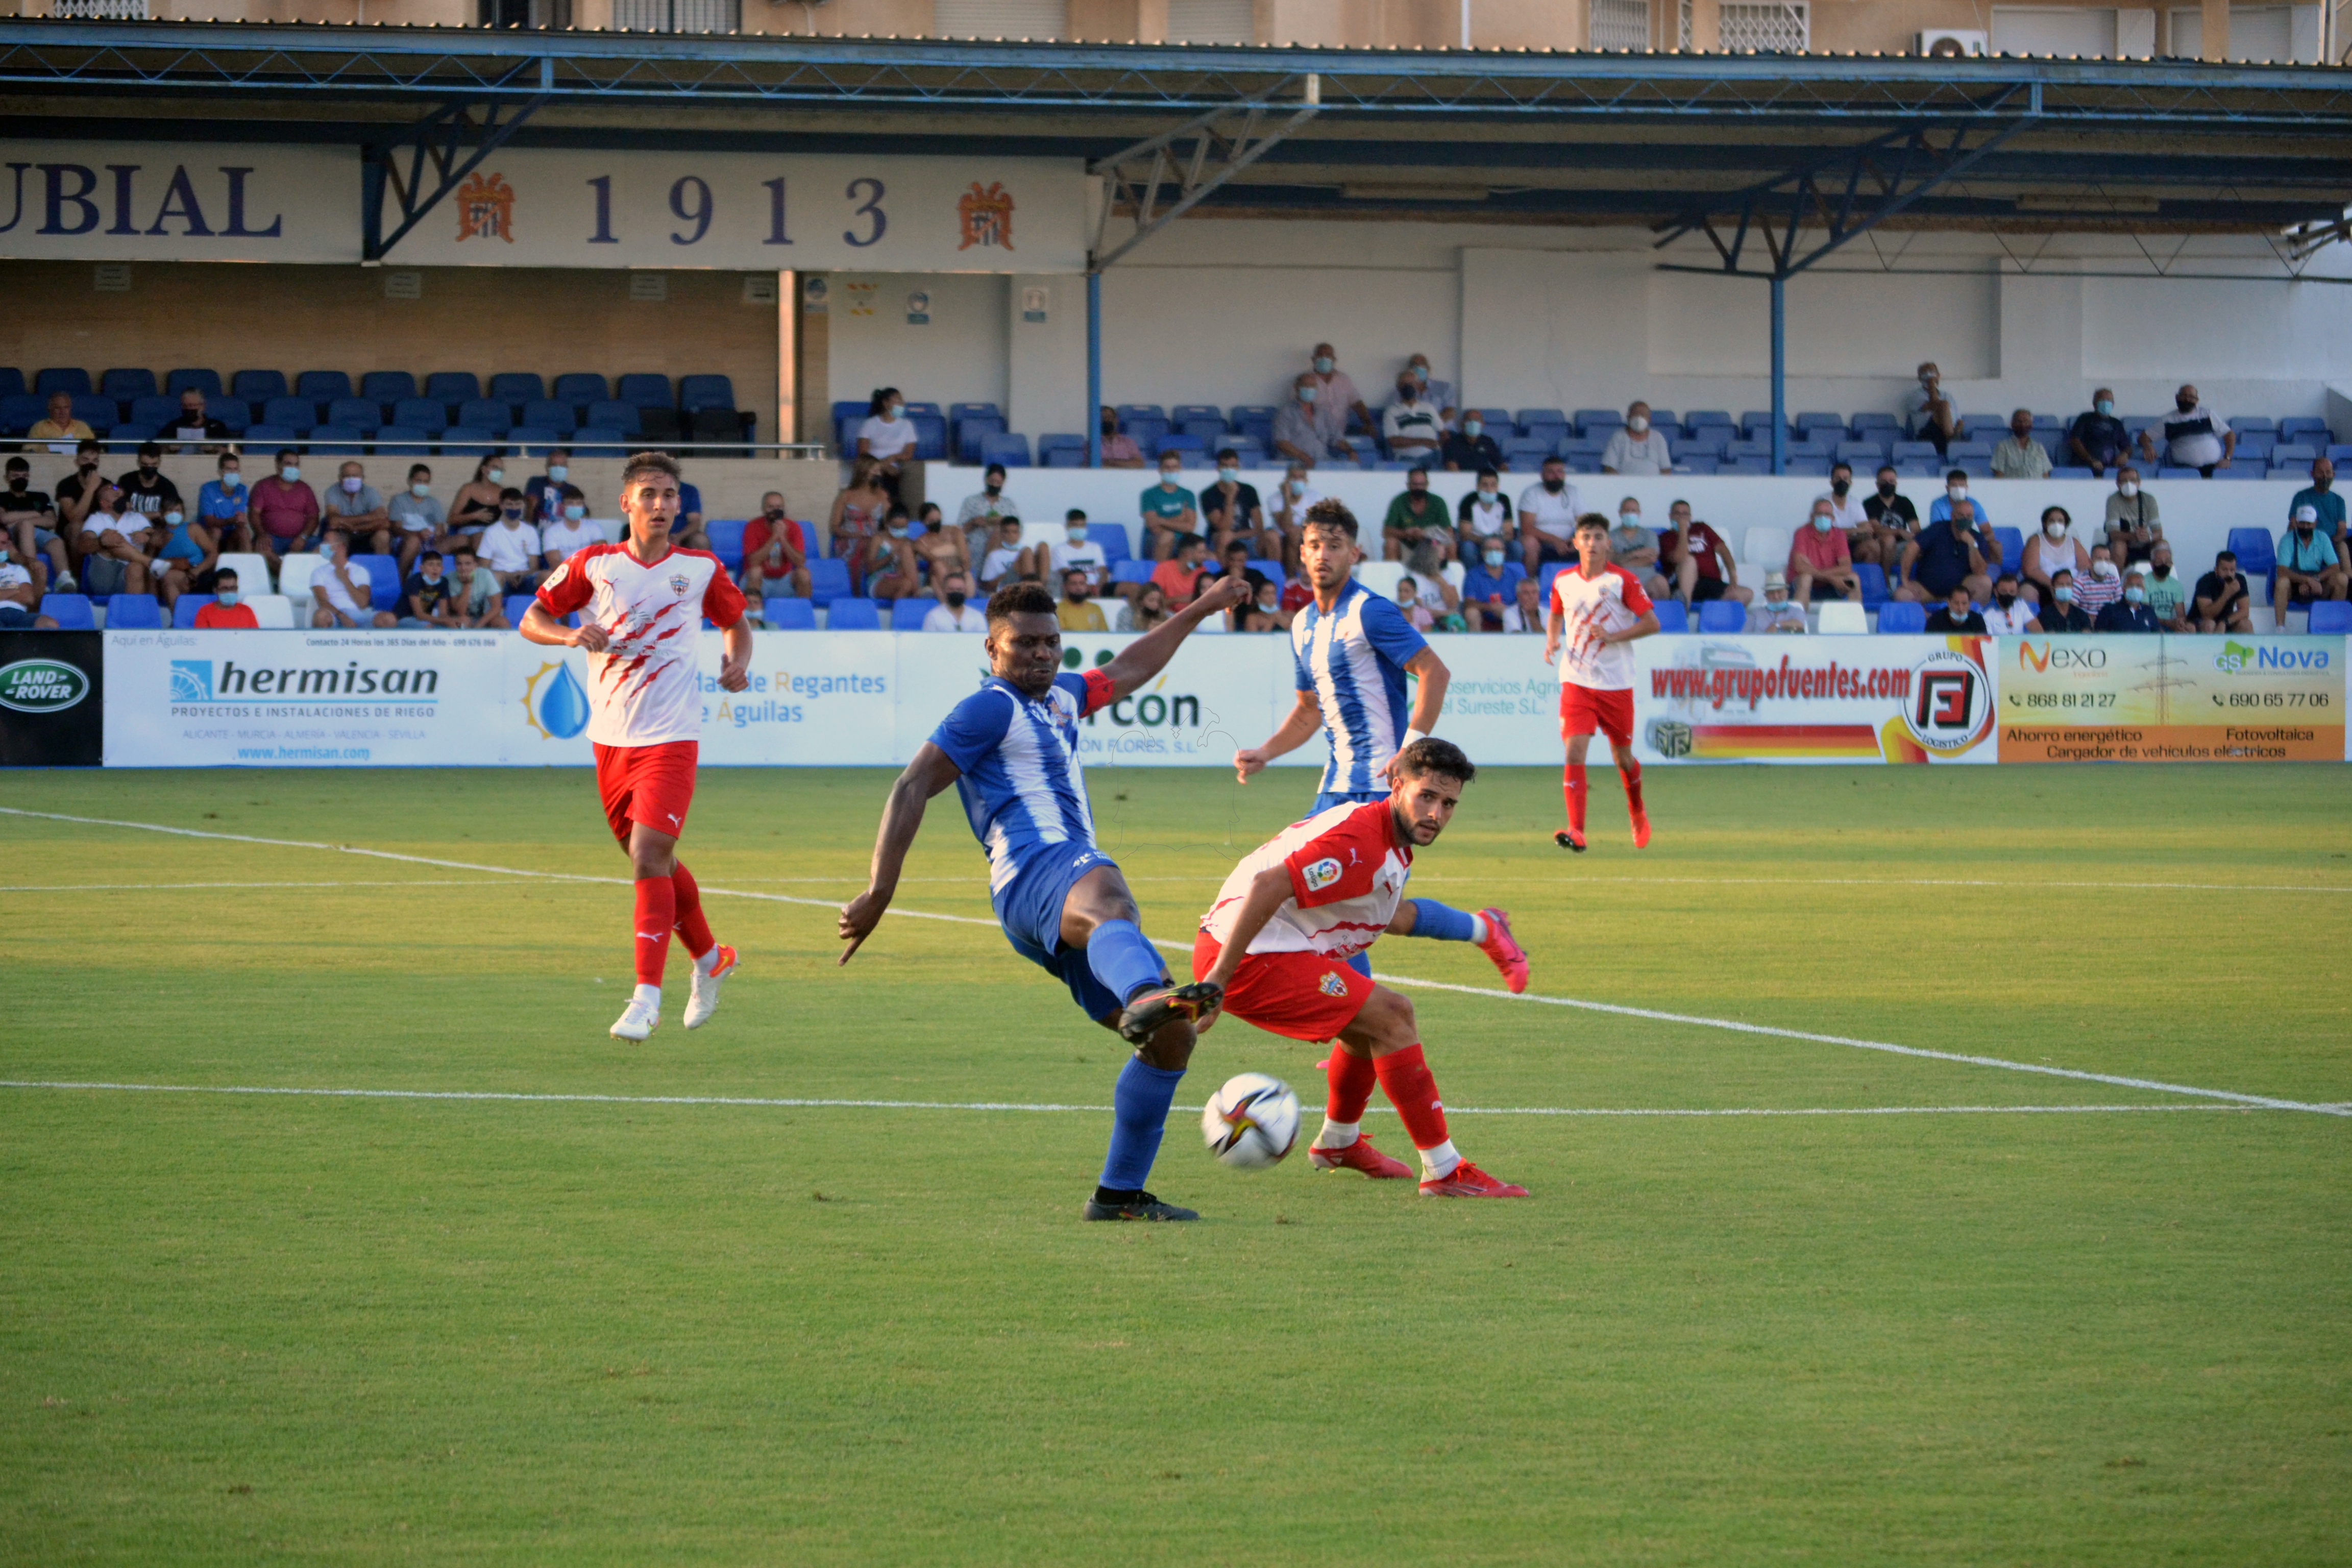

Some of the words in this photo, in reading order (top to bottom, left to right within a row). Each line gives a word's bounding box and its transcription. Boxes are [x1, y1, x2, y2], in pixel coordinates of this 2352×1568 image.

[587, 175, 887, 248] 1913
[111, 635, 137, 648] Aquí
[1927, 651, 1963, 663] GRUPO
[2019, 640, 2106, 674] Nexo
[2212, 653, 2242, 671] GS
[2259, 646, 2329, 669] Nova
[11, 671, 53, 684] LAND
[219, 662, 438, 694] hermisan
[775, 671, 886, 699] Regantes
[1651, 654, 1910, 710] www.grupofuentes.com
[15, 685, 72, 699] ROVER
[1445, 678, 1522, 695] oservicios
[1457, 698, 1515, 715] Sureste
[1518, 698, 1545, 715] S.L.
[2027, 693, 2058, 707] 868
[2062, 693, 2076, 707] 81
[2080, 693, 2094, 707] 21
[2098, 693, 2116, 707] 27
[2230, 693, 2259, 707] 690
[2264, 693, 2283, 707] 65
[2287, 693, 2305, 707] 77
[2309, 693, 2329, 707] 06
[172, 707, 249, 717] PROYECTOS
[255, 707, 261, 717] E
[266, 707, 369, 717] INSTALACIONES
[374, 707, 390, 717] DE
[395, 707, 434, 717] RIEGO
[717, 696, 803, 728] Águilas
[183, 730, 228, 739] ALICANTE
[237, 730, 275, 739] MURCIA
[333, 730, 380, 739] VALENCIA
[388, 730, 426, 739] SEVILLA
[1922, 734, 1969, 749] LOGISTICO
[2006, 729, 2060, 742] Ahorro
[2064, 728, 2142, 744] energético
[2226, 728, 2314, 741] Fotovoltaica
[237, 745, 370, 759] www.hermisan.com
[1079, 735, 1101, 753] ÓN
[1173, 739, 1197, 753] S.L.
[2047, 744, 2115, 761] Cargador
[2119, 745, 2137, 759] de
[2214, 744, 2286, 758] eléctricos
